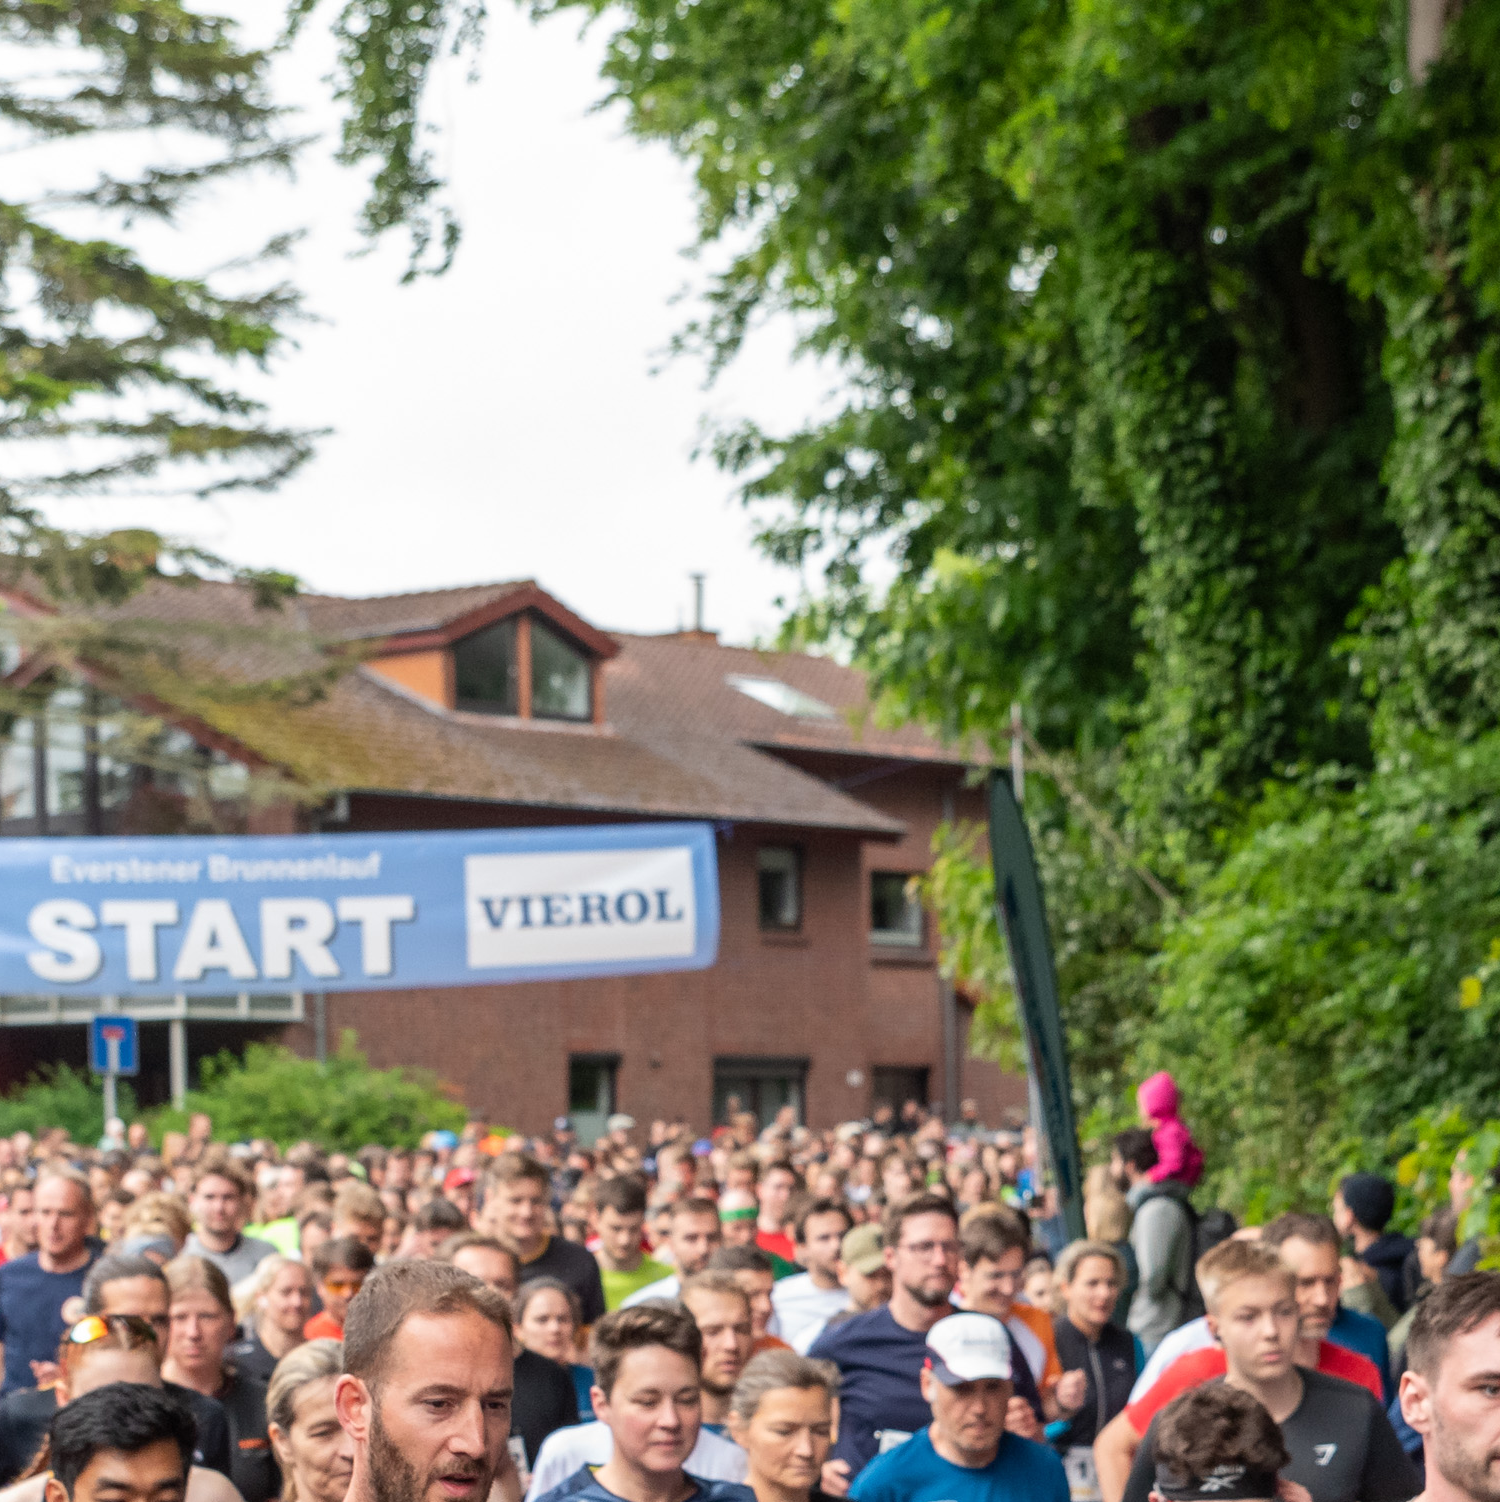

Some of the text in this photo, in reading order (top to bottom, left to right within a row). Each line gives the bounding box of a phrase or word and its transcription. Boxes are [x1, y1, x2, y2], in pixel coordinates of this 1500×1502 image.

[50, 850, 381, 884] Everstener Brunnenlauf
[479, 887, 685, 930] VIEROL
[27, 895, 415, 984] START
